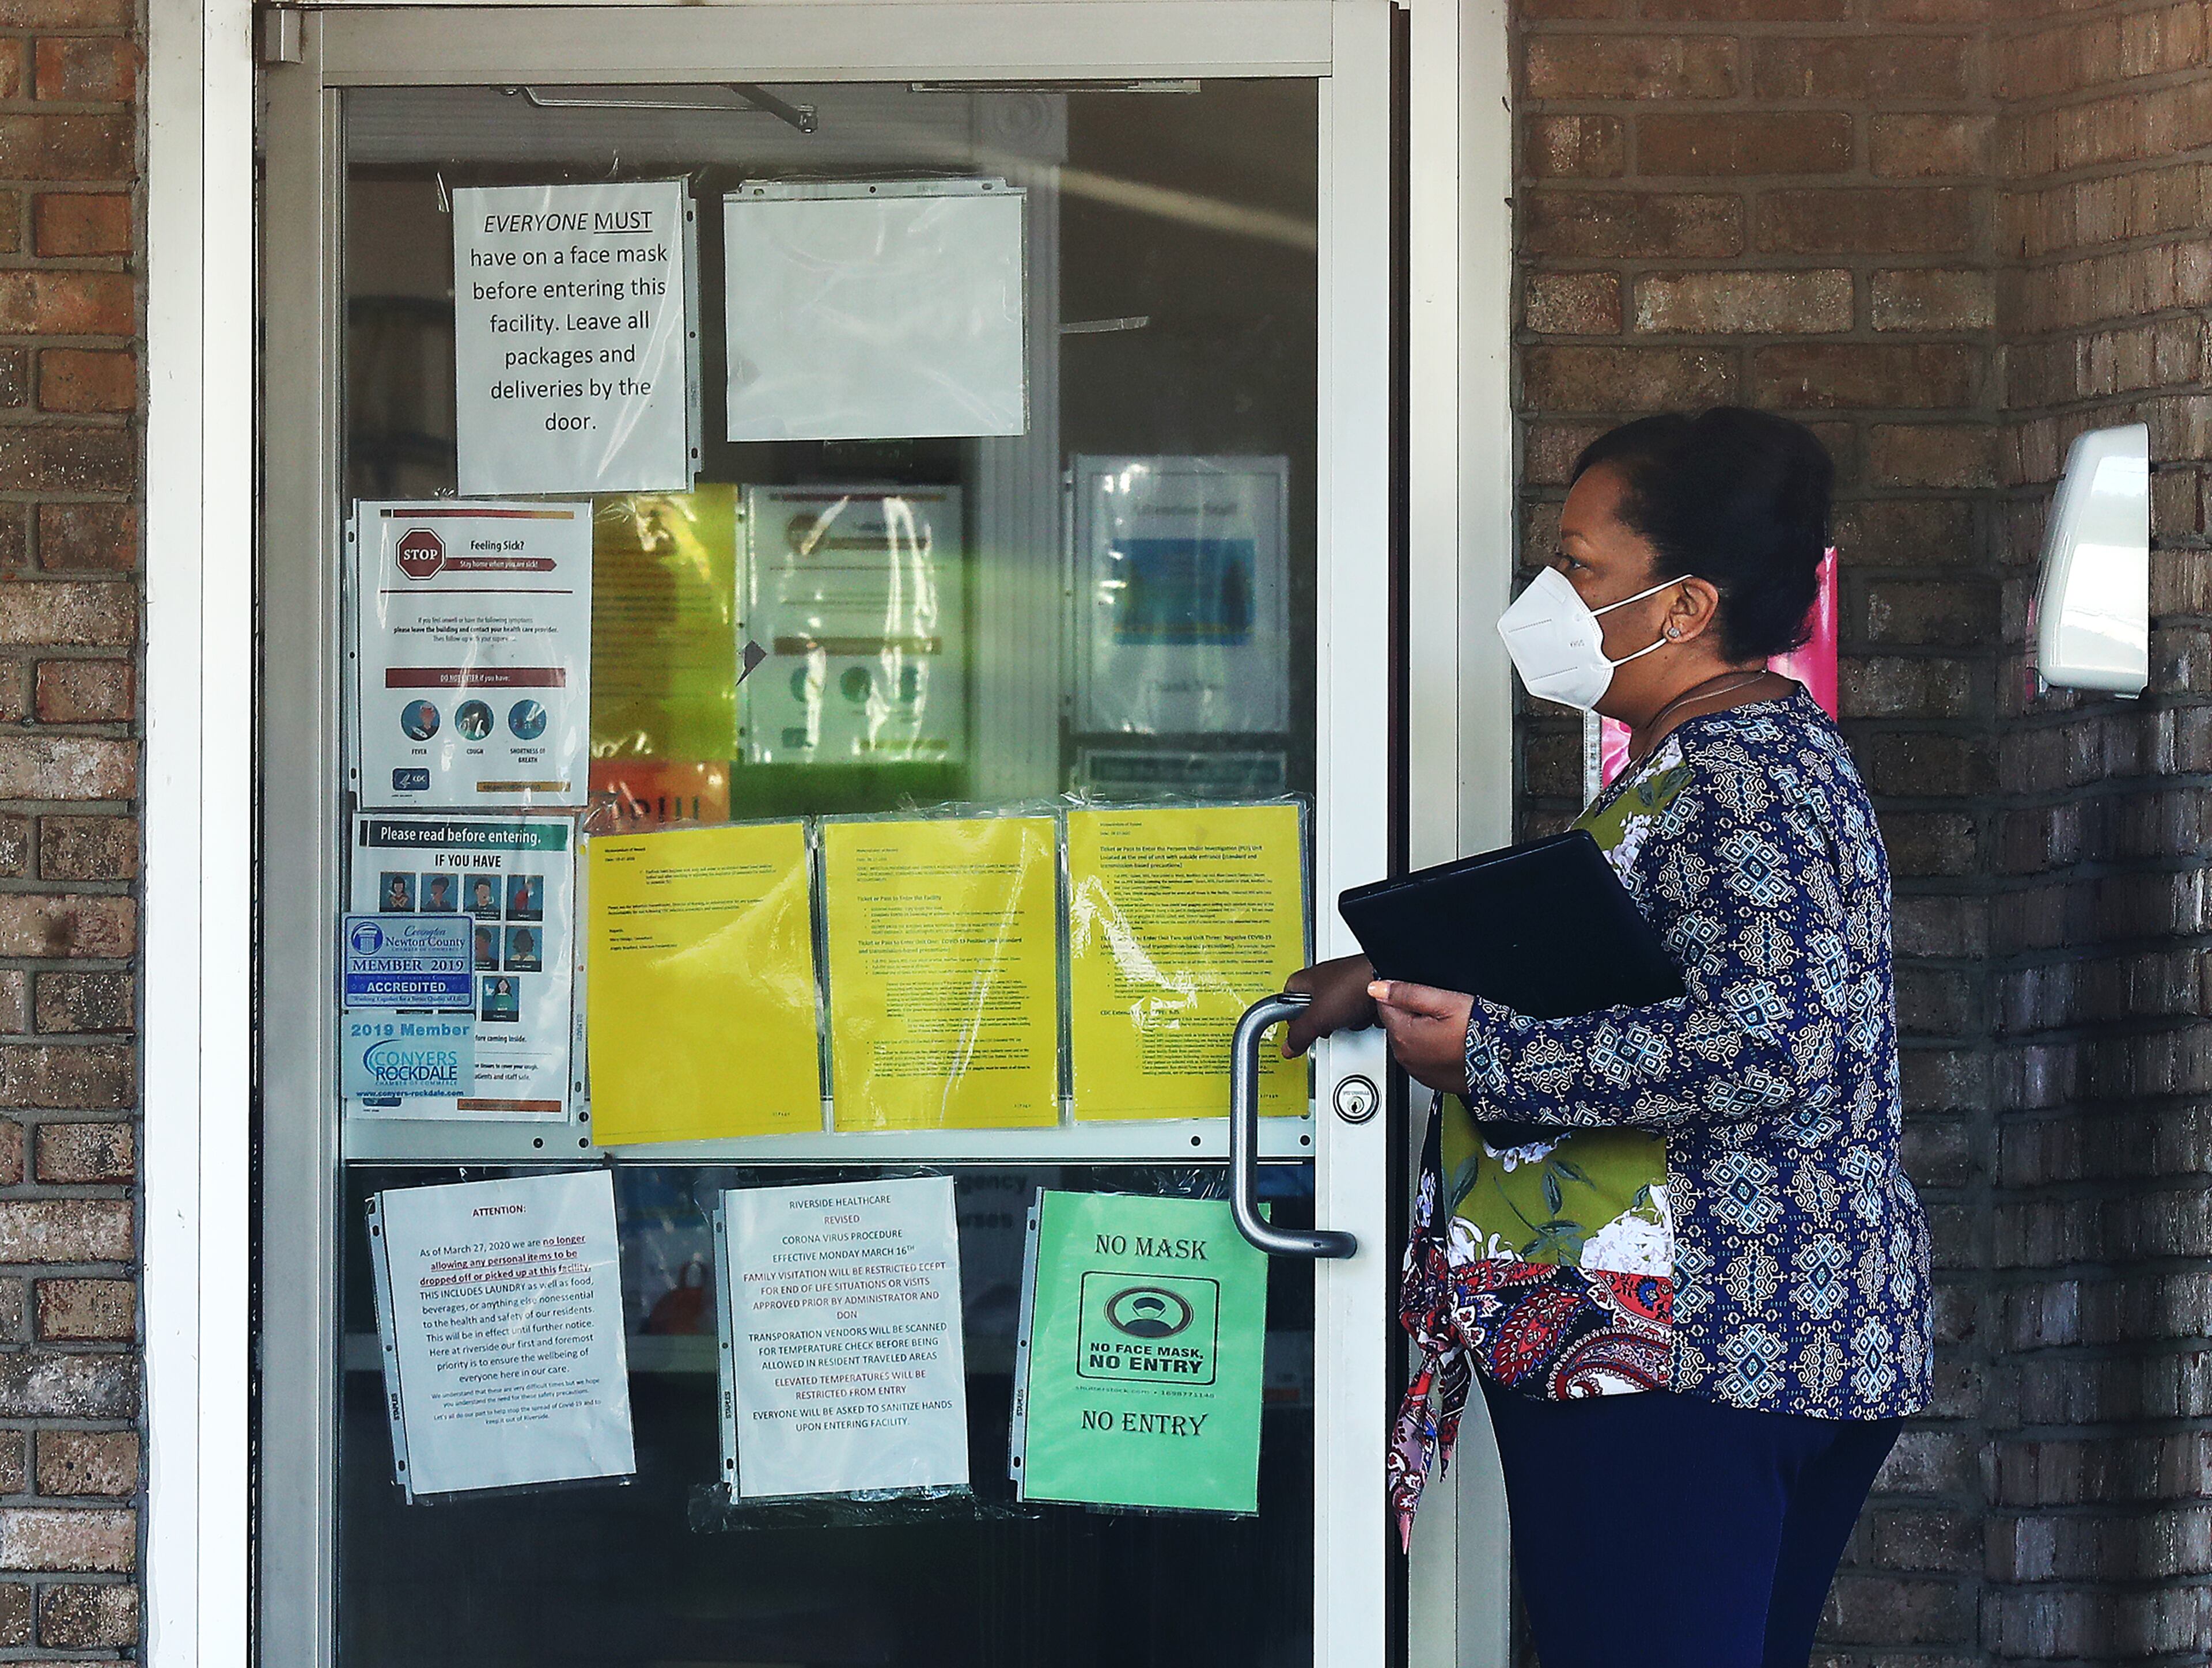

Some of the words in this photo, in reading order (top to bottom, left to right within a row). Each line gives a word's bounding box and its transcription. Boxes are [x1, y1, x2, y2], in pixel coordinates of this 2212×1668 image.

[484, 213, 588, 232] EVERYONE
[594, 211, 653, 229] MUST
[471, 248, 516, 266] have
[522, 252, 546, 265] on
[554, 251, 563, 264] a
[570, 245, 609, 263] face
[617, 244, 667, 262] mask
[473, 281, 537, 300] before
[543, 279, 624, 300] entering
[631, 277, 665, 295] this
[490, 314, 559, 335] facility.
[567, 314, 621, 330] Leave
[627, 310, 649, 328] all
[505, 347, 593, 369] packages
[599, 344, 635, 362] and
[491, 380, 583, 399] deliveries
[590, 378, 612, 400] by
[618, 377, 651, 395] the
[545, 412, 596, 430] door.
[470, 540, 502, 552] Feeling
[503, 540, 524, 550] Sick?
[404, 549, 438, 560] STOP
[460, 560, 472, 568] Stay
[435, 625, 458, 634] building
[381, 826, 416, 840] Please
[419, 827, 445, 841] read
[447, 828, 485, 841] before
[488, 829, 541, 846] entering.
[435, 854, 445, 866] IF
[448, 854, 469, 866] YOU
[472, 855, 501, 867] HAVE
[385, 937, 425, 946] Newton
[428, 937, 465, 949] County
[353, 959, 422, 971] MEMBER
[430, 959, 464, 971] 2019
[351, 1023, 394, 1036] 2019
[400, 1023, 470, 1036] Member
[487, 1035, 507, 1043] coming
[375, 1051, 457, 1066] CONYERS
[376, 1066, 458, 1081] ROCKDALE
[356, 1090, 464, 1098] www.conyers-rockdale.com
[789, 1199, 833, 1208] RIVERSIDE
[835, 1195, 891, 1206] HEALTHCARE
[472, 1205, 526, 1216] ATTENTION:
[824, 1214, 860, 1224] REVISED
[782, 1234, 821, 1245] CORONA
[822, 1233, 849, 1242] VIRUS
[851, 1229, 902, 1240] PROCEDURE
[1095, 1234, 1126, 1254] NO
[1135, 1237, 1207, 1260] MASK
[772, 1252, 816, 1263] EFFECTIVE
[819, 1250, 859, 1260] MONDAY
[861, 1248, 893, 1257] MARCH
[743, 1272, 776, 1282] FAMILY
[778, 1269, 827, 1279] VISITATION
[828, 1268, 850, 1276] WILL
[852, 1267, 862, 1275] BE
[865, 1263, 916, 1274] RESTRICTED
[919, 1261, 946, 1271] ECEPT
[419, 1291, 439, 1300] THIS
[441, 1287, 483, 1298] INCLUDES
[484, 1283, 525, 1294] LAUNDRY
[570, 1277, 594, 1286] food,
[760, 1287, 779, 1295] FOR
[781, 1285, 799, 1294] END
[801, 1284, 812, 1293] OF
[815, 1283, 832, 1292] LIFE
[834, 1280, 887, 1291] SITUATIONS
[888, 1279, 902, 1287] OR
[903, 1277, 930, 1286] VISITS
[752, 1299, 800, 1309] APPROVED
[802, 1298, 828, 1306] PRIOR
[831, 1297, 842, 1305] BY
[844, 1292, 918, 1304] ADMINISTRATOR
[919, 1291, 939, 1299] AND
[836, 1310, 857, 1320] DON
[426, 1334, 444, 1342] This
[445, 1332, 460, 1340] will
[461, 1330, 472, 1339] be
[484, 1328, 509, 1337] effect
[512, 1325, 531, 1334] until
[532, 1322, 563, 1332] further
[565, 1320, 594, 1329] notice.
[429, 1348, 449, 1356] Here
[462, 1343, 499, 1353] riverside
[517, 1339, 535, 1348] first
[536, 1336, 553, 1346] and
[555, 1334, 593, 1344] foremost
[1090, 1342, 1110, 1352] NO
[1115, 1344, 1152, 1355] FACE
[1157, 1347, 1203, 1359] MASK,
[1089, 1354, 1120, 1368] NO
[1129, 1357, 1202, 1374] ENTRY
[459, 1373, 498, 1382] everyone
[499, 1370, 520, 1378] here
[796, 1389, 847, 1400] RESTRICTED
[849, 1387, 876, 1396] FROM
[878, 1386, 906, 1395] ENTRY
[796, 1422, 821, 1432] UPON
[824, 1419, 868, 1430] ENTERING
[870, 1417, 910, 1427] FACILITY.
[1081, 1410, 1113, 1430] NO
[1121, 1413, 1208, 1436] ENTRY
